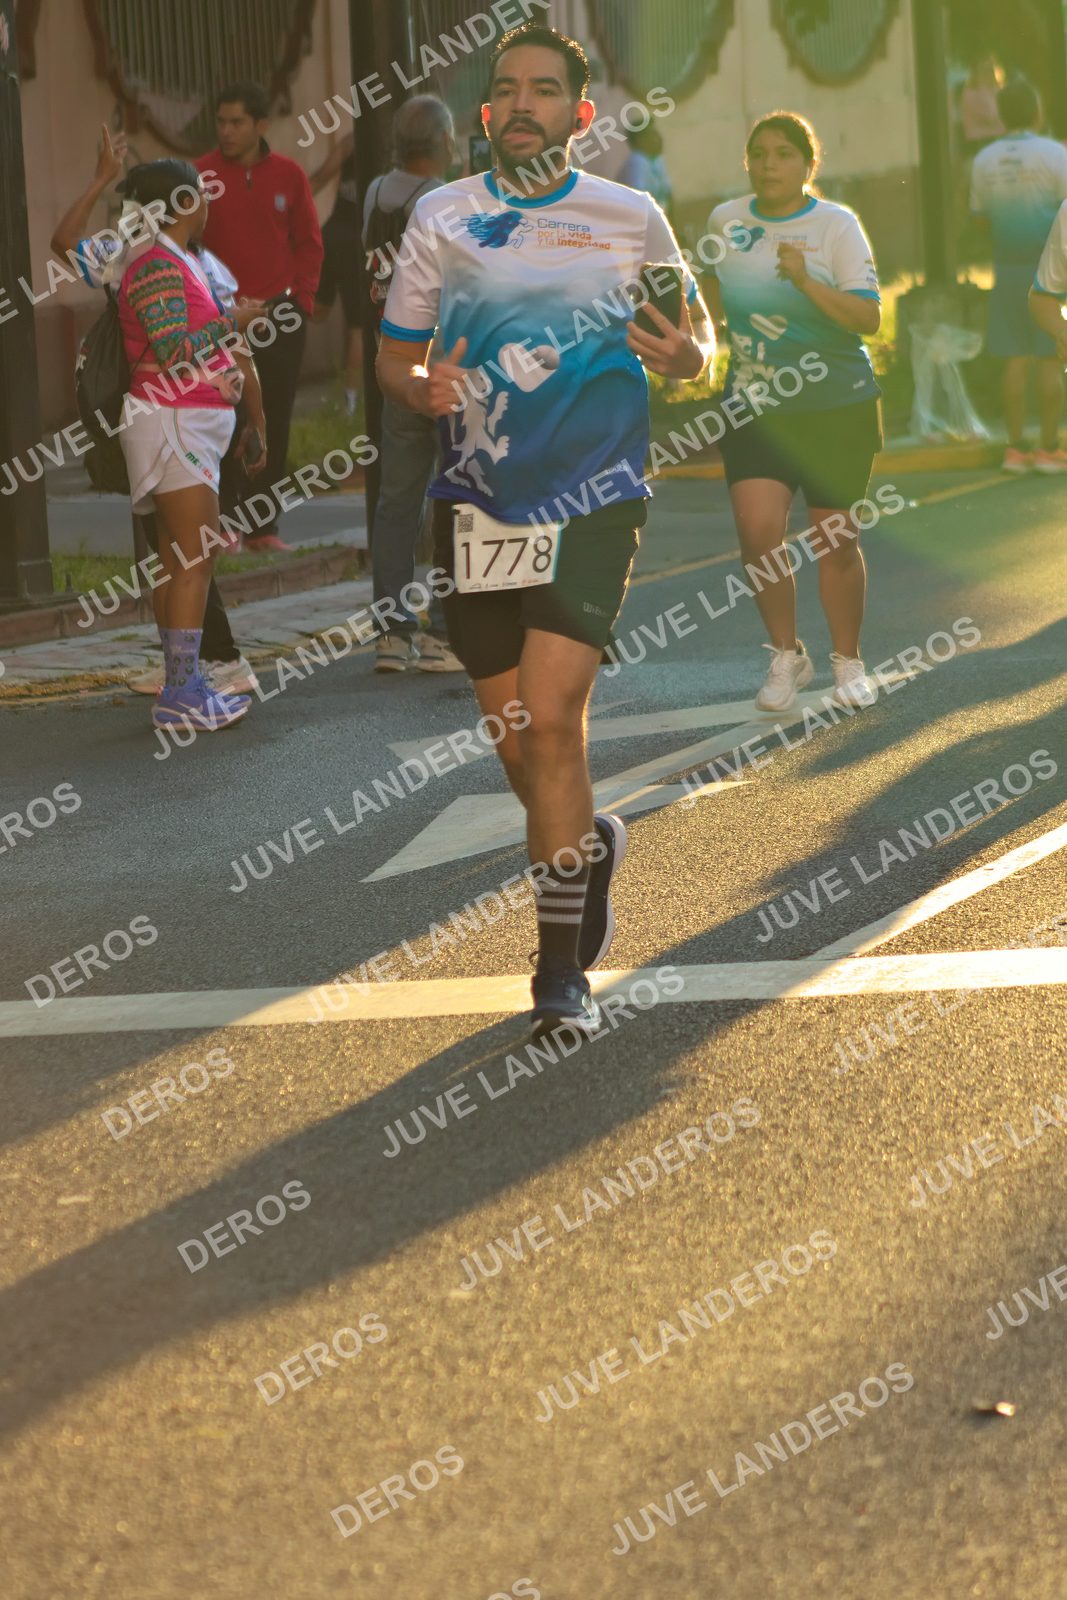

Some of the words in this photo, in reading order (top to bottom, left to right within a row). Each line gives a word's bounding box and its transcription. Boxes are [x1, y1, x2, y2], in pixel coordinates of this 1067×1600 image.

[537, 218, 590, 233] Carrera
[537, 230, 554, 240] por
[568, 231, 592, 241] vida
[461, 535, 553, 579] 1778
